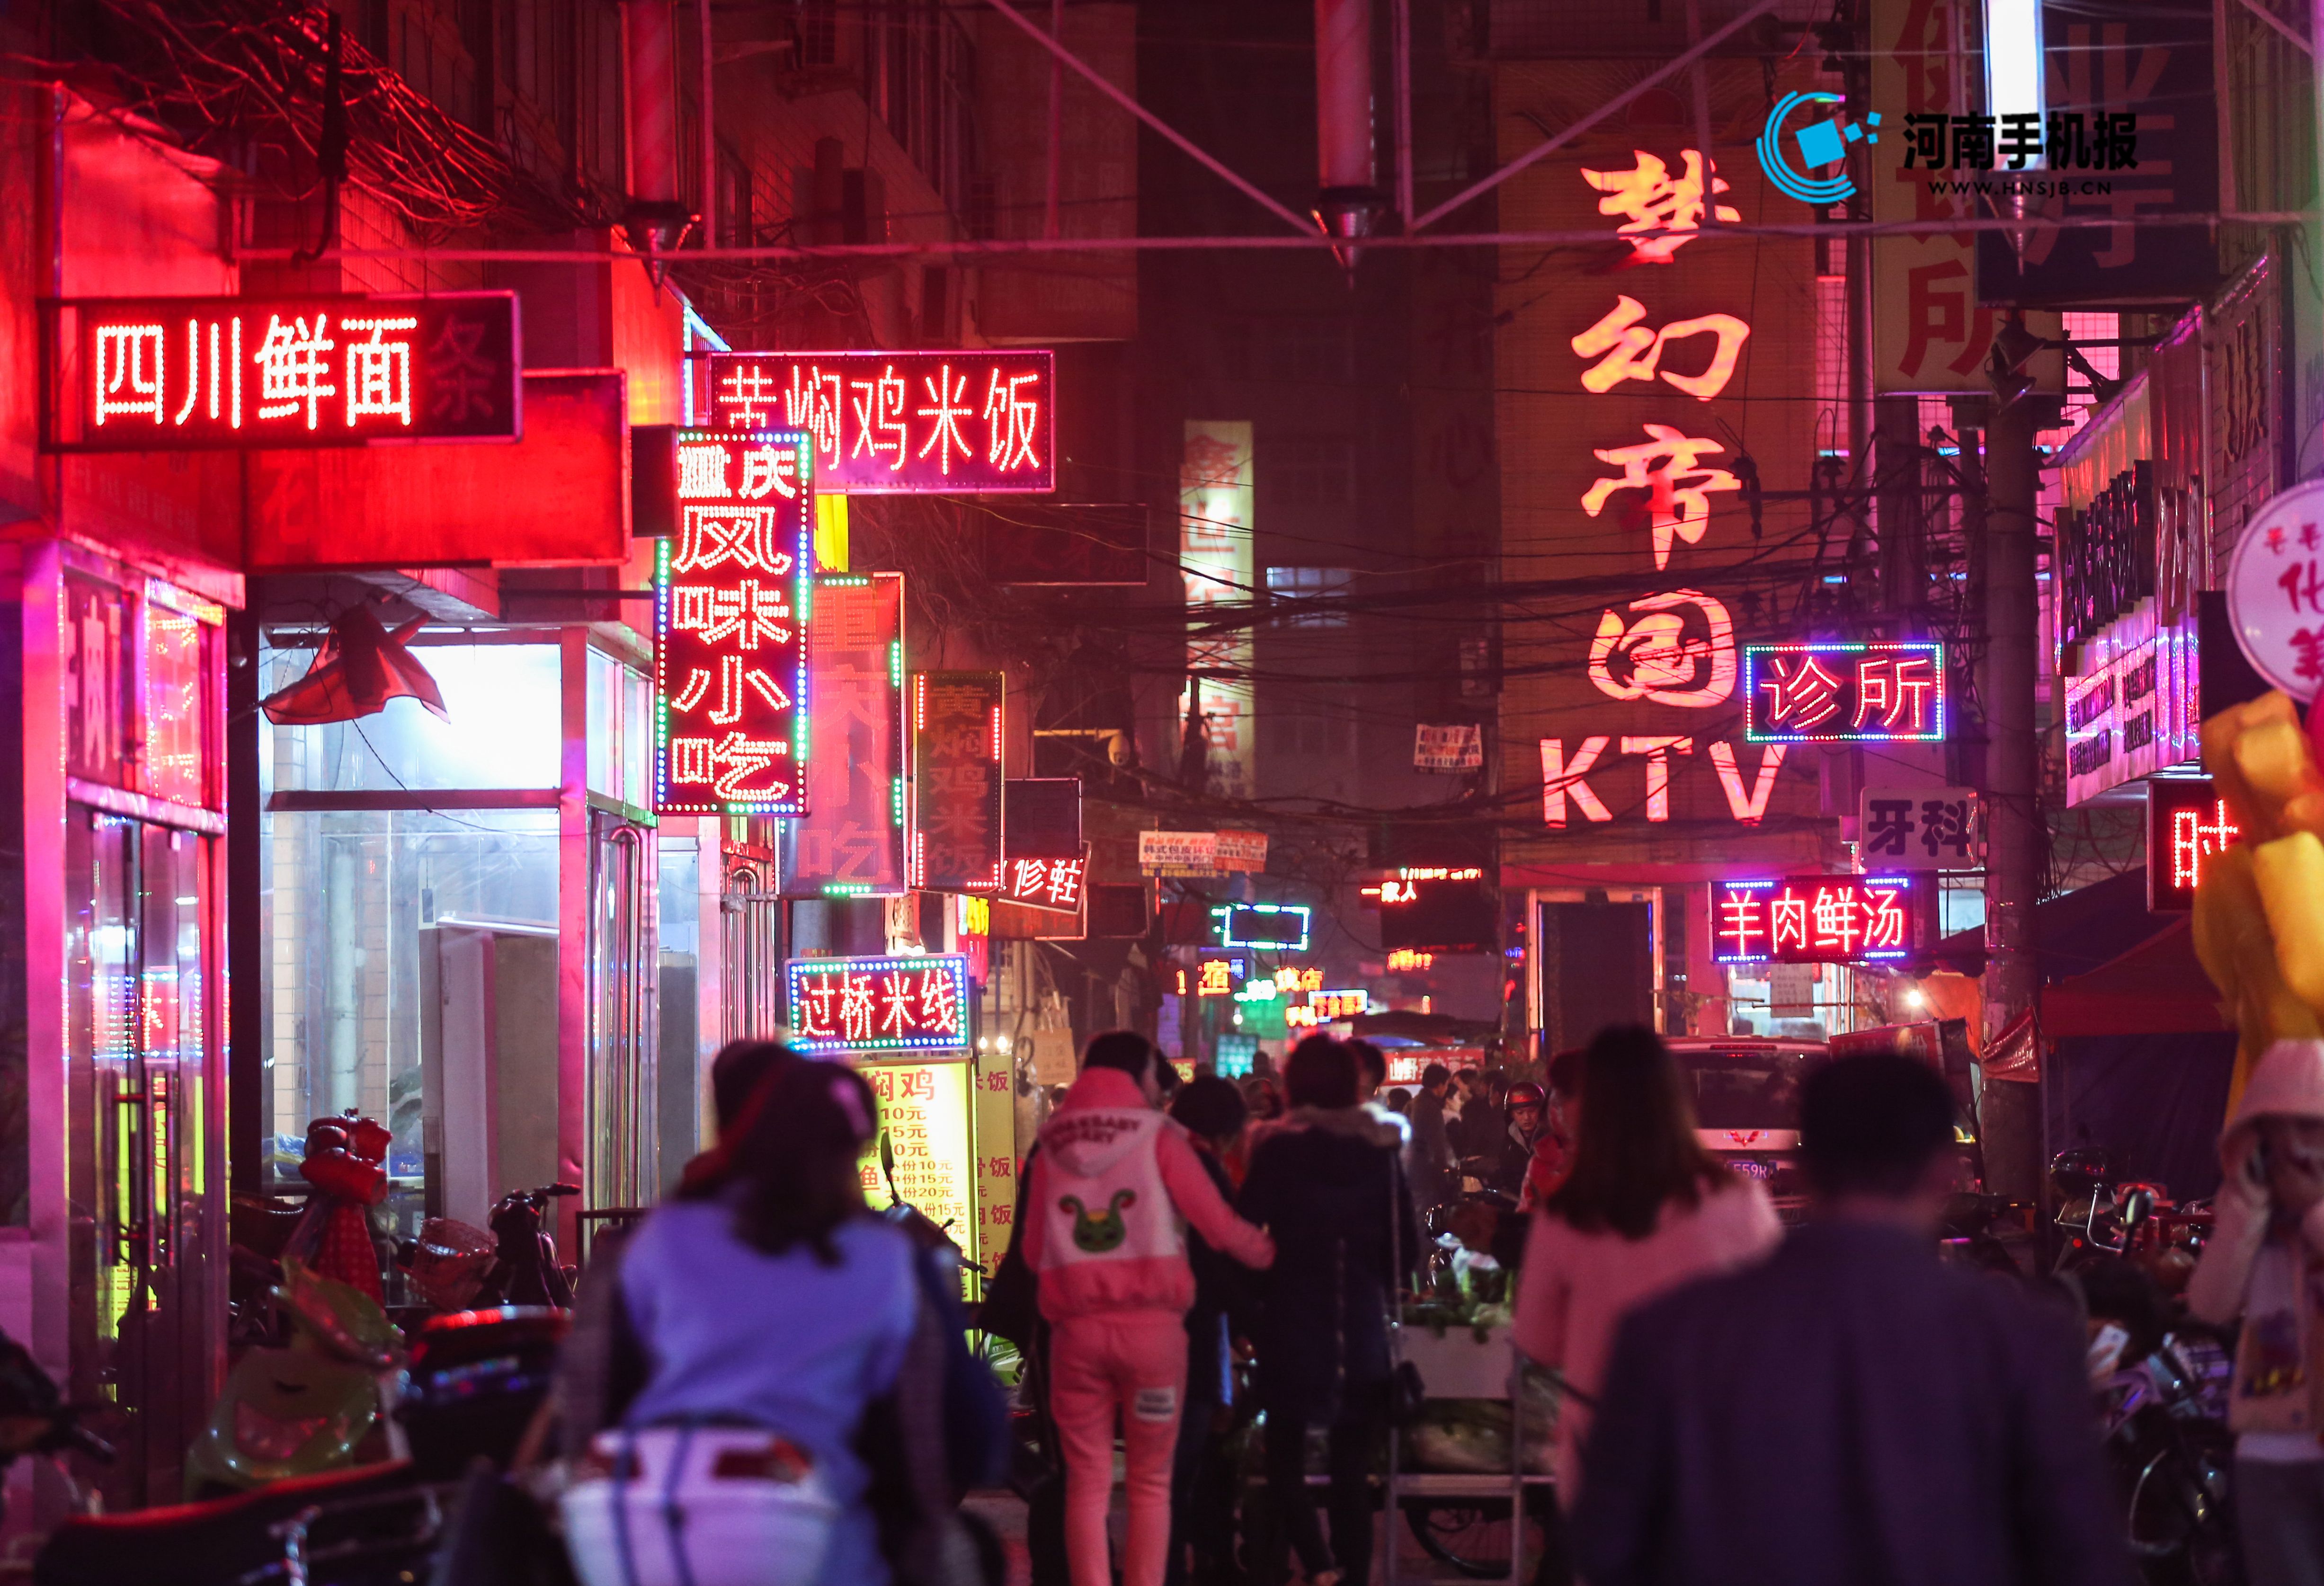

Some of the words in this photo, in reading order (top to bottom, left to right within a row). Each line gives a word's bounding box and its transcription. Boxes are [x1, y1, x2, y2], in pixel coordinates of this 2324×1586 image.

[1759, 655, 1933, 731] 诊所
[929, 684, 990, 876] 黄焖鸡米饭
[1540, 736, 1787, 829] KTV
[1868, 799, 1970, 857] 牙科
[1014, 859, 1082, 904] 修鞋
[1719, 886, 1903, 955] 羊肉鲜汤
[800, 968, 958, 1040] 过桥米线
[880, 1106, 927, 1121] 10元
[894, 1143, 928, 1157] 0元
